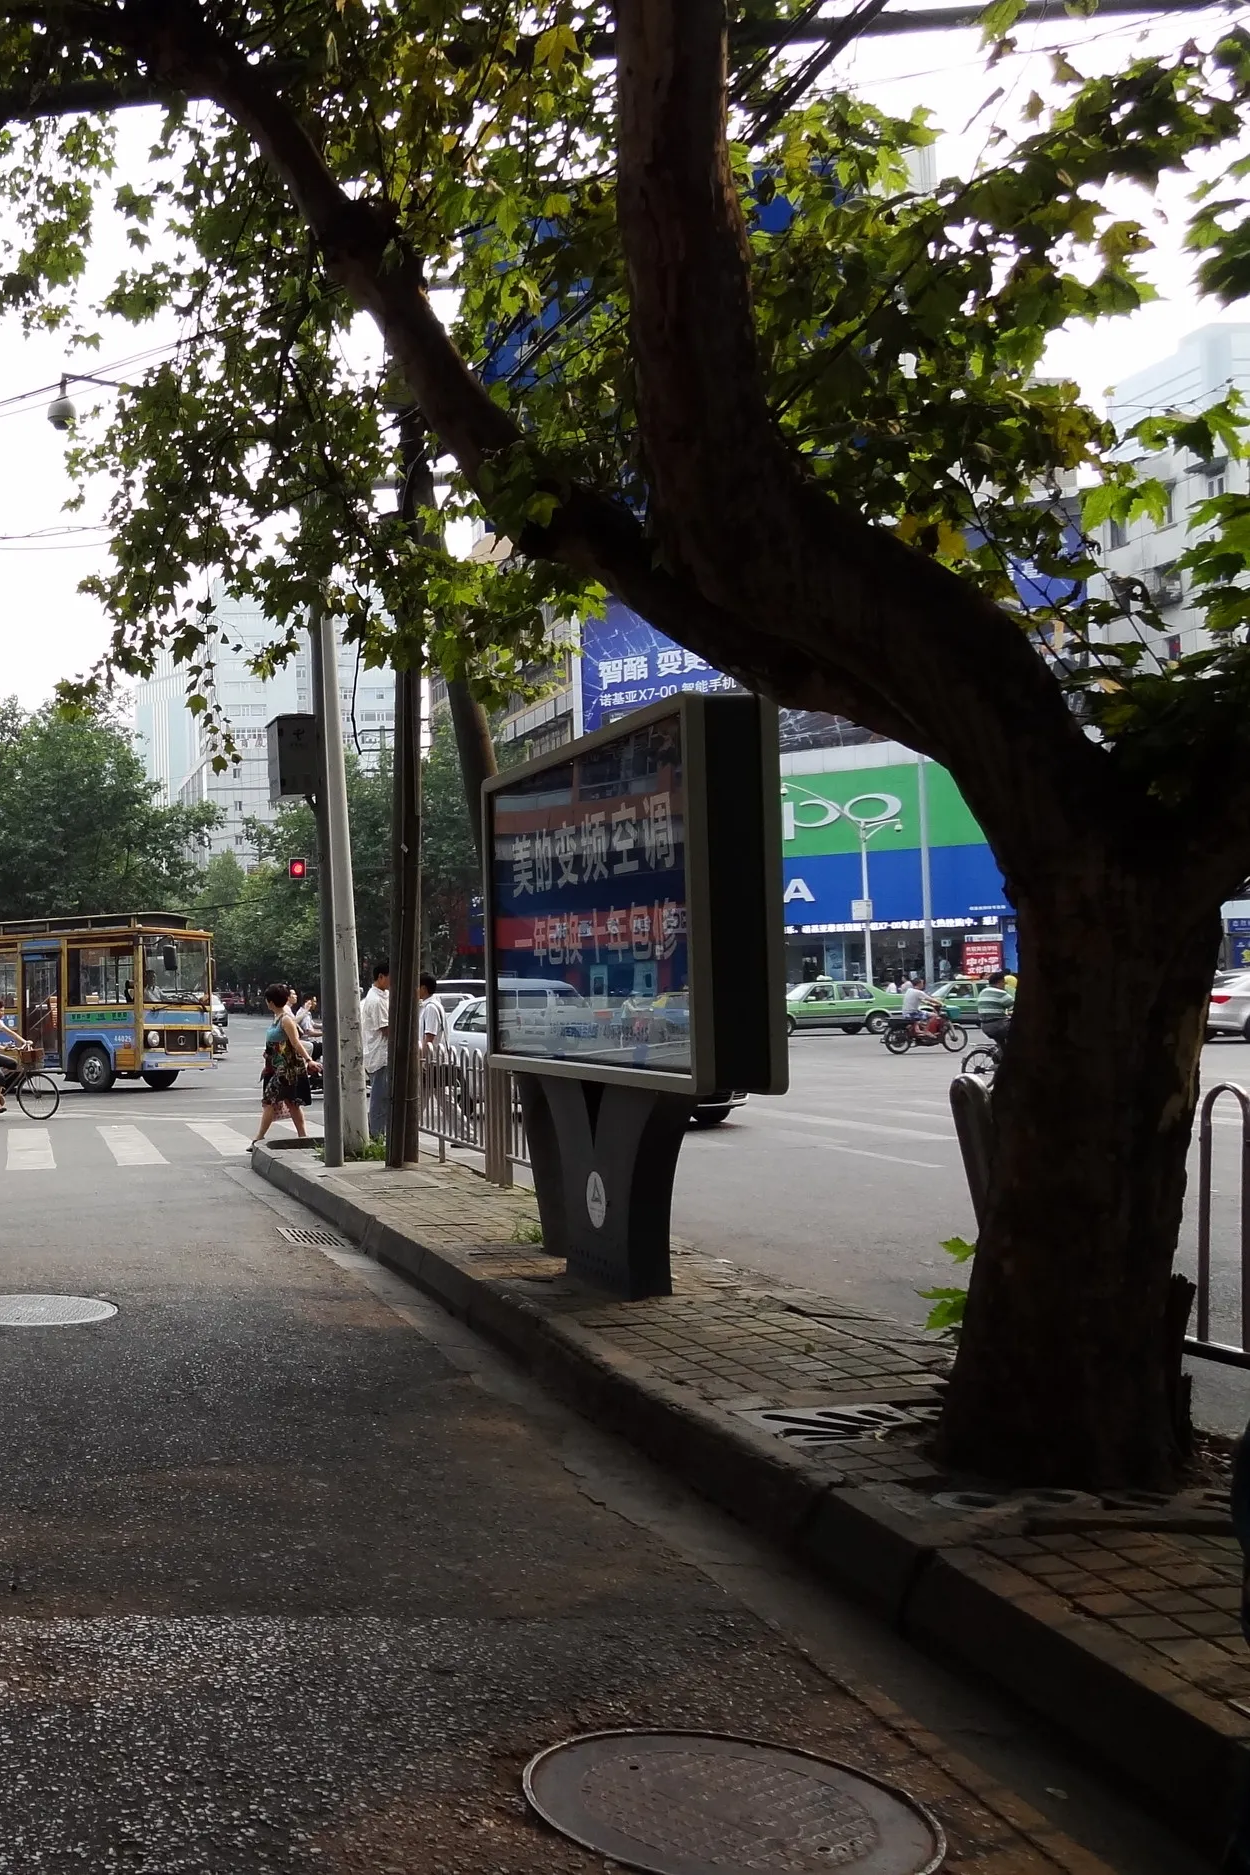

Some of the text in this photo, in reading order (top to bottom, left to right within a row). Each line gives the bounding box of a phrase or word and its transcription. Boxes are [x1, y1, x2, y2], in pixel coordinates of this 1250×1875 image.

[598, 655, 649, 690] 智酷
[682, 676, 737, 693] 智能手机
[512, 791, 676, 898] 美的变频空调
[965, 957, 1000, 967] 中小学
